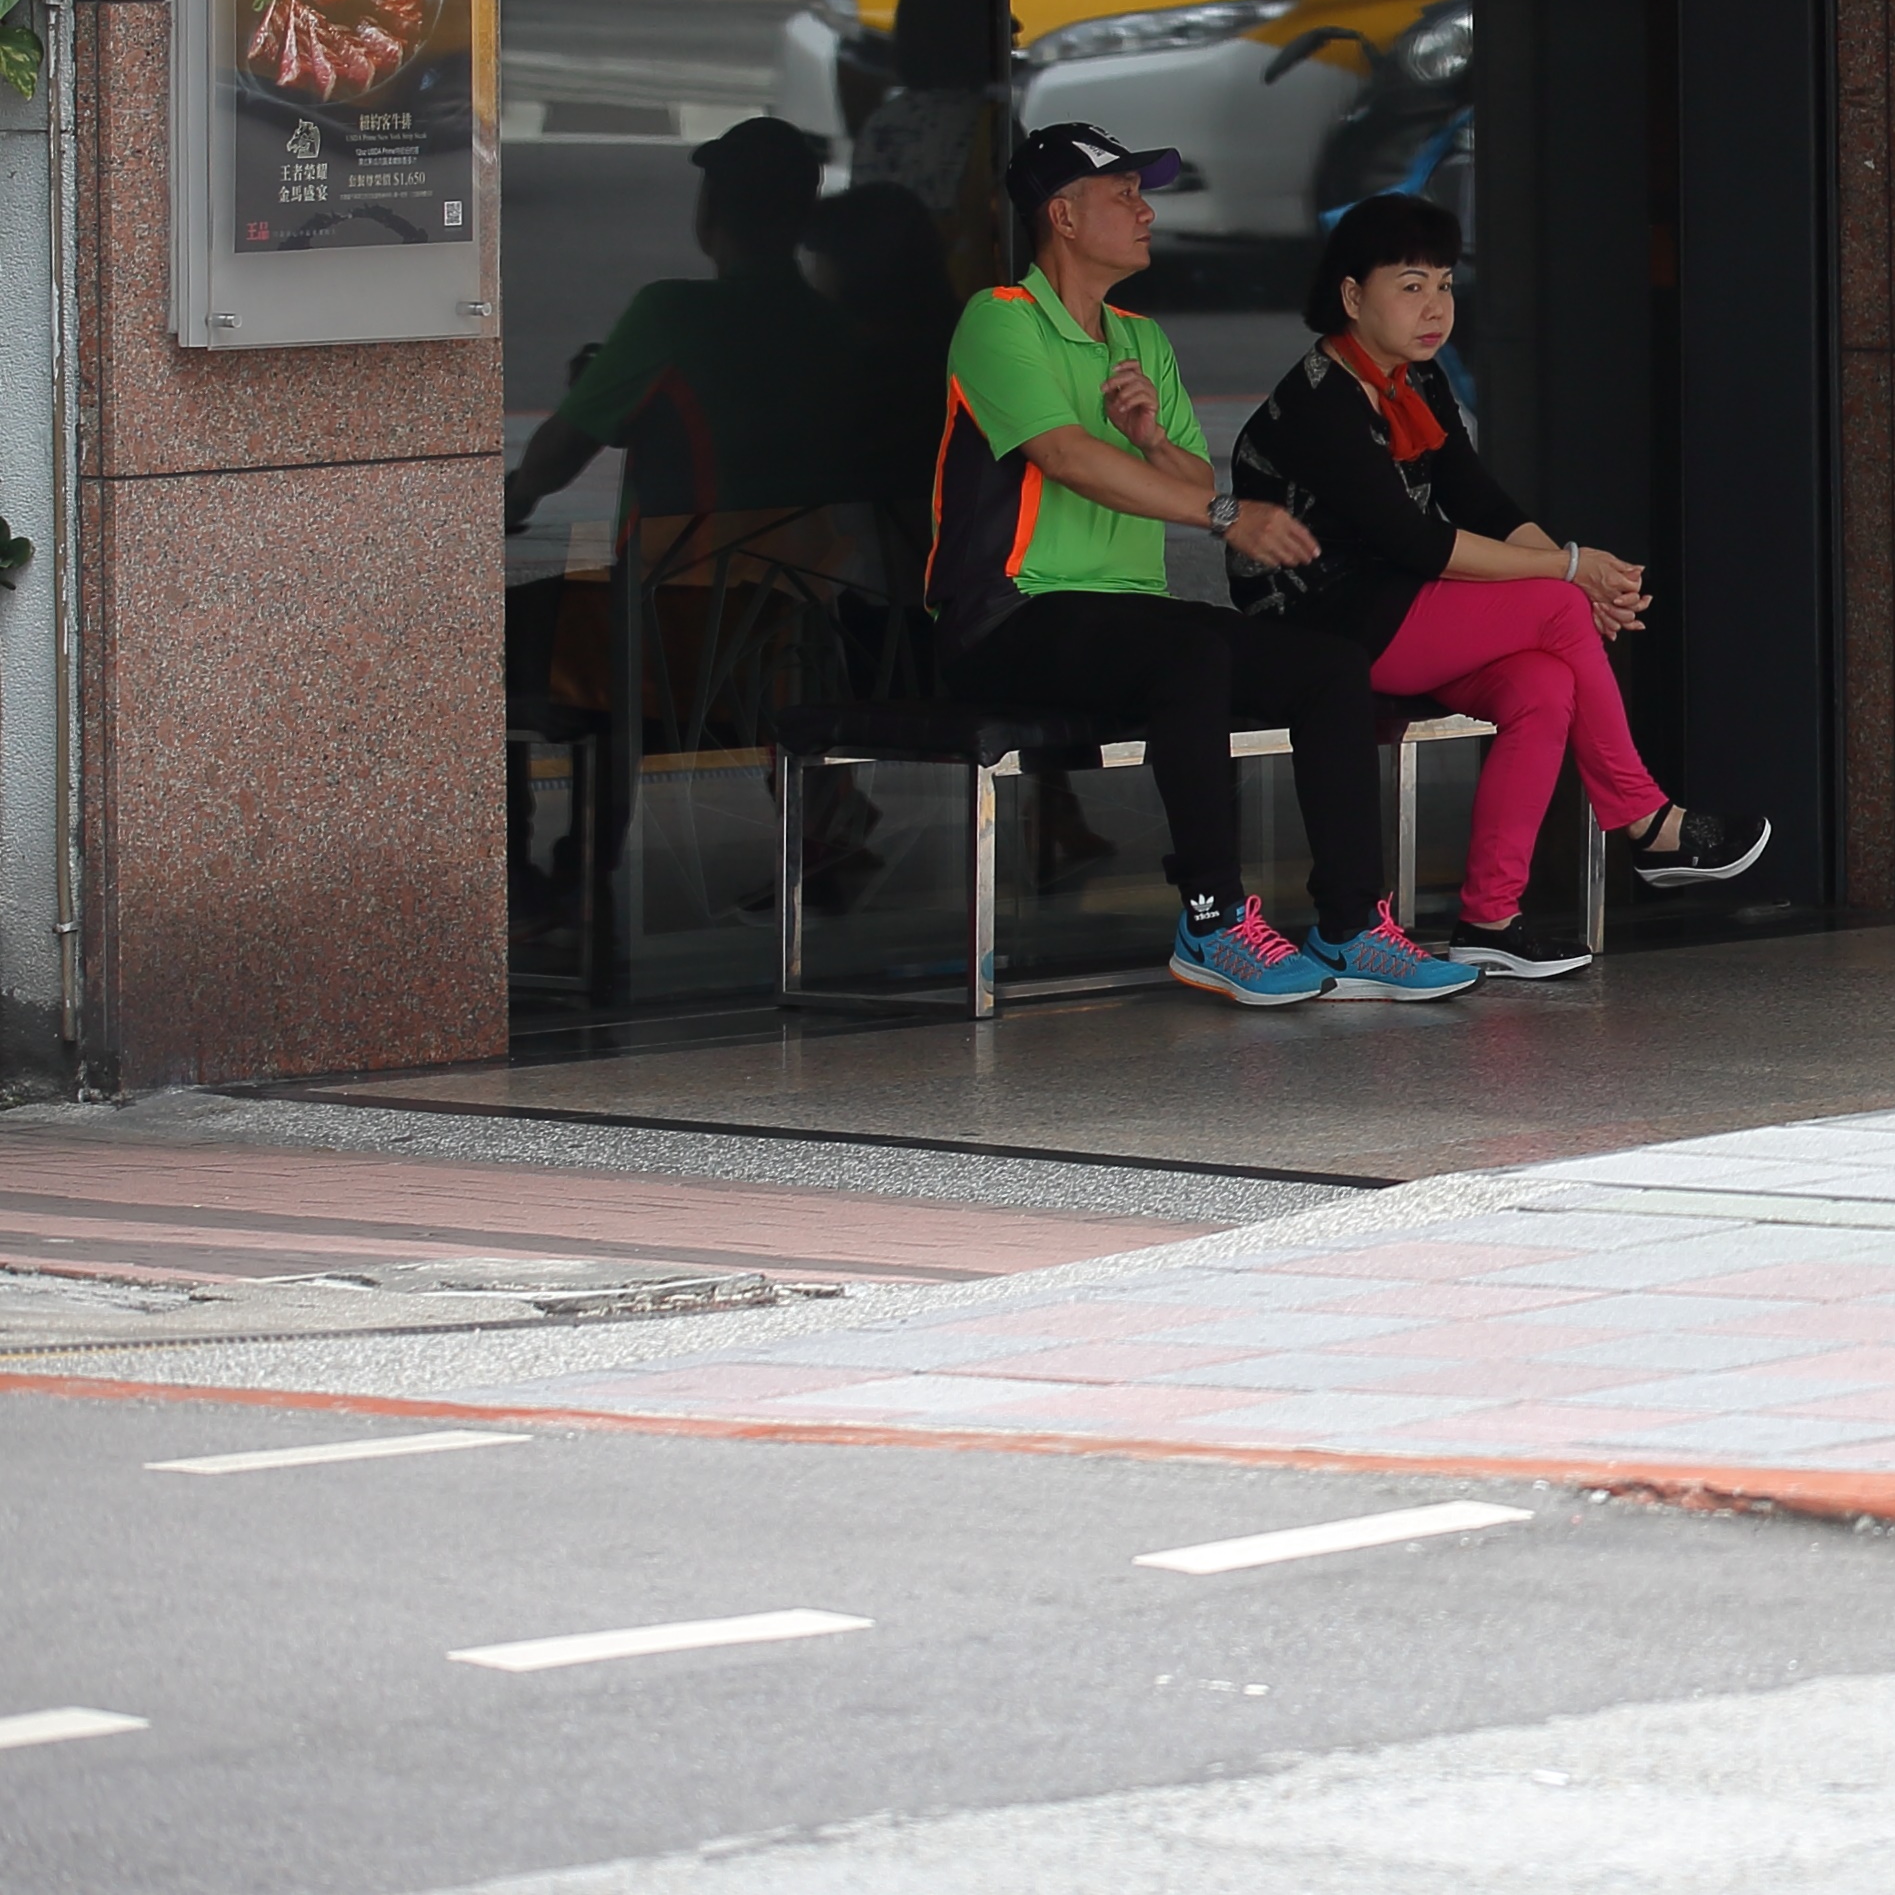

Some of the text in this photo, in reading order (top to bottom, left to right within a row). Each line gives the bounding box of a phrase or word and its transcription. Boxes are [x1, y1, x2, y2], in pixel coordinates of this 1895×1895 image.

[280, 163, 328, 182] 王者榮耀
[279, 184, 329, 203] 金馬盛宴
[246, 221, 270, 241] 王品
[1194, 910, 1220, 921] adidas
